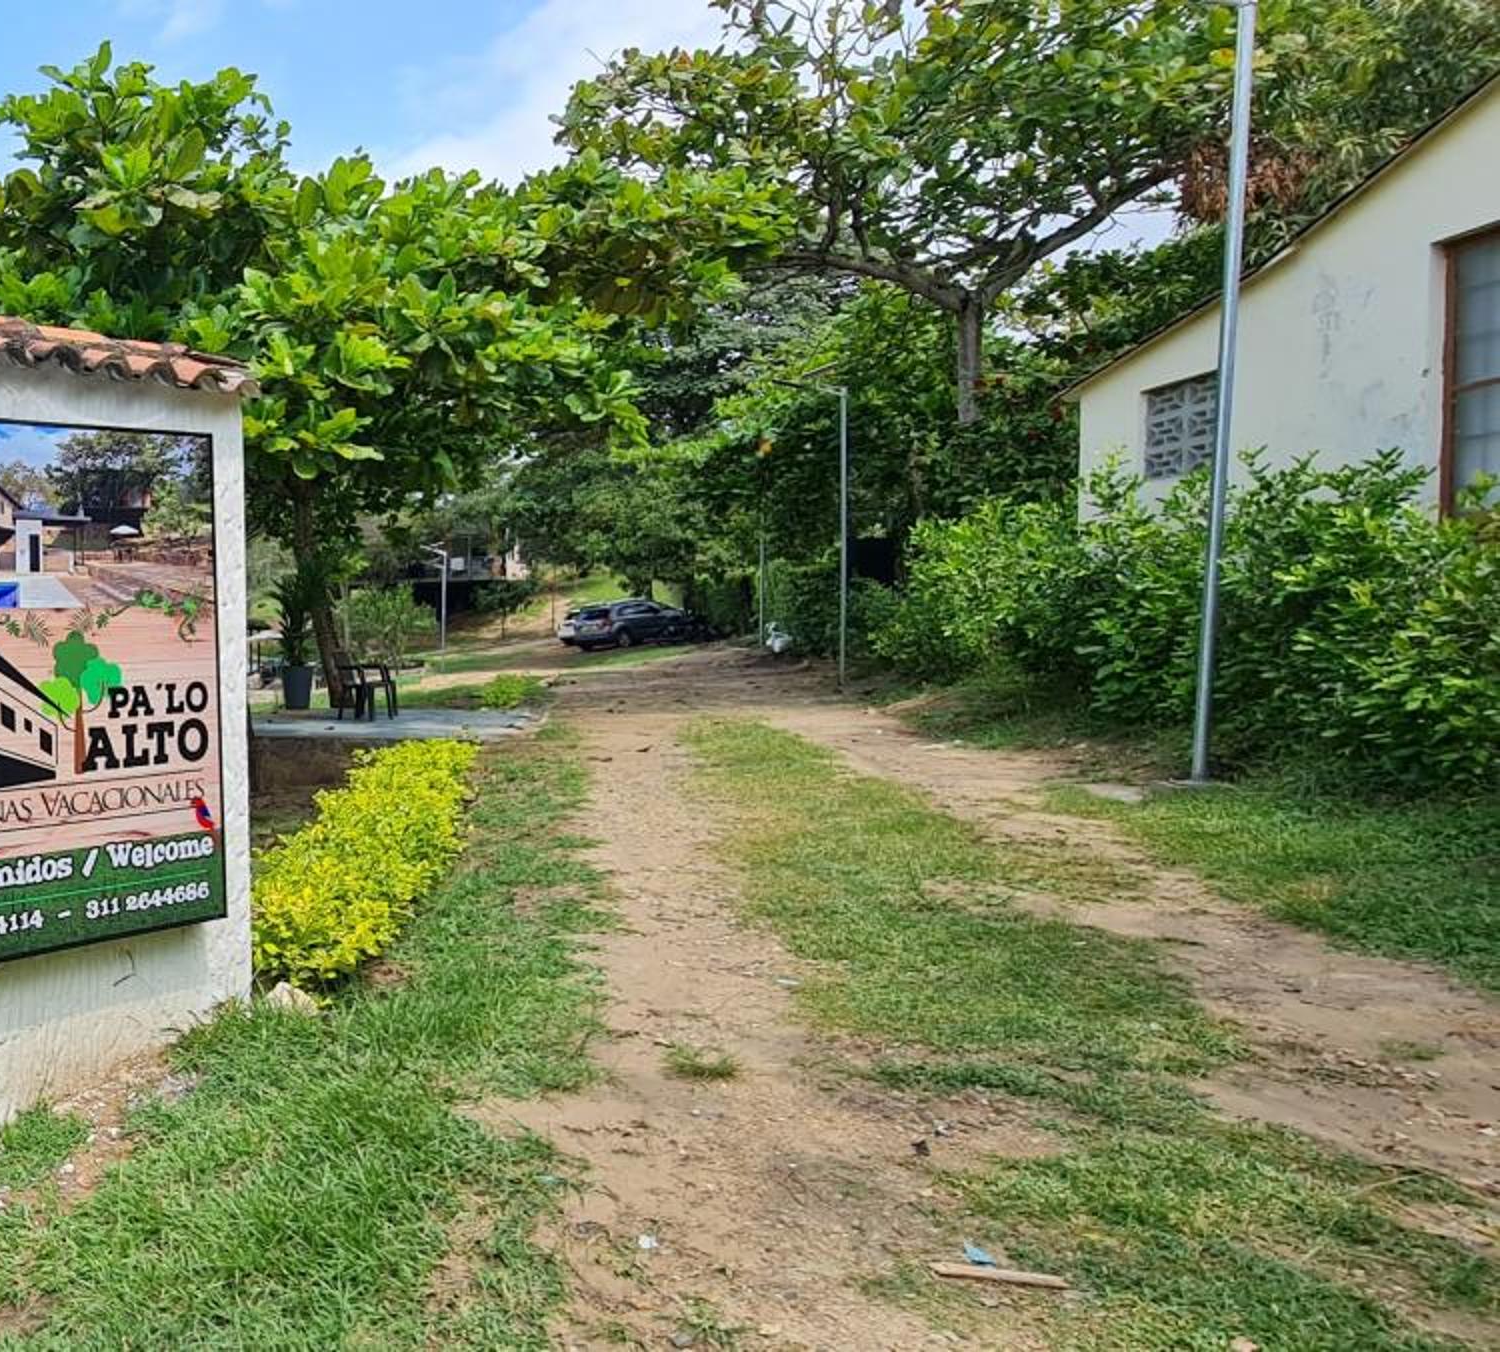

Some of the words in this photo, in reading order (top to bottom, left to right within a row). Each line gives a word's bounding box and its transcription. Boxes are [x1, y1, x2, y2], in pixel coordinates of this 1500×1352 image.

[82, 718, 209, 772] ALTO
[41, 778, 205, 816] VACACIONALES
[82, 848, 99, 877] /
[106, 836, 214, 867] Welcome
[86, 897, 120, 919] 311
[125, 882, 210, 911] 2644686
